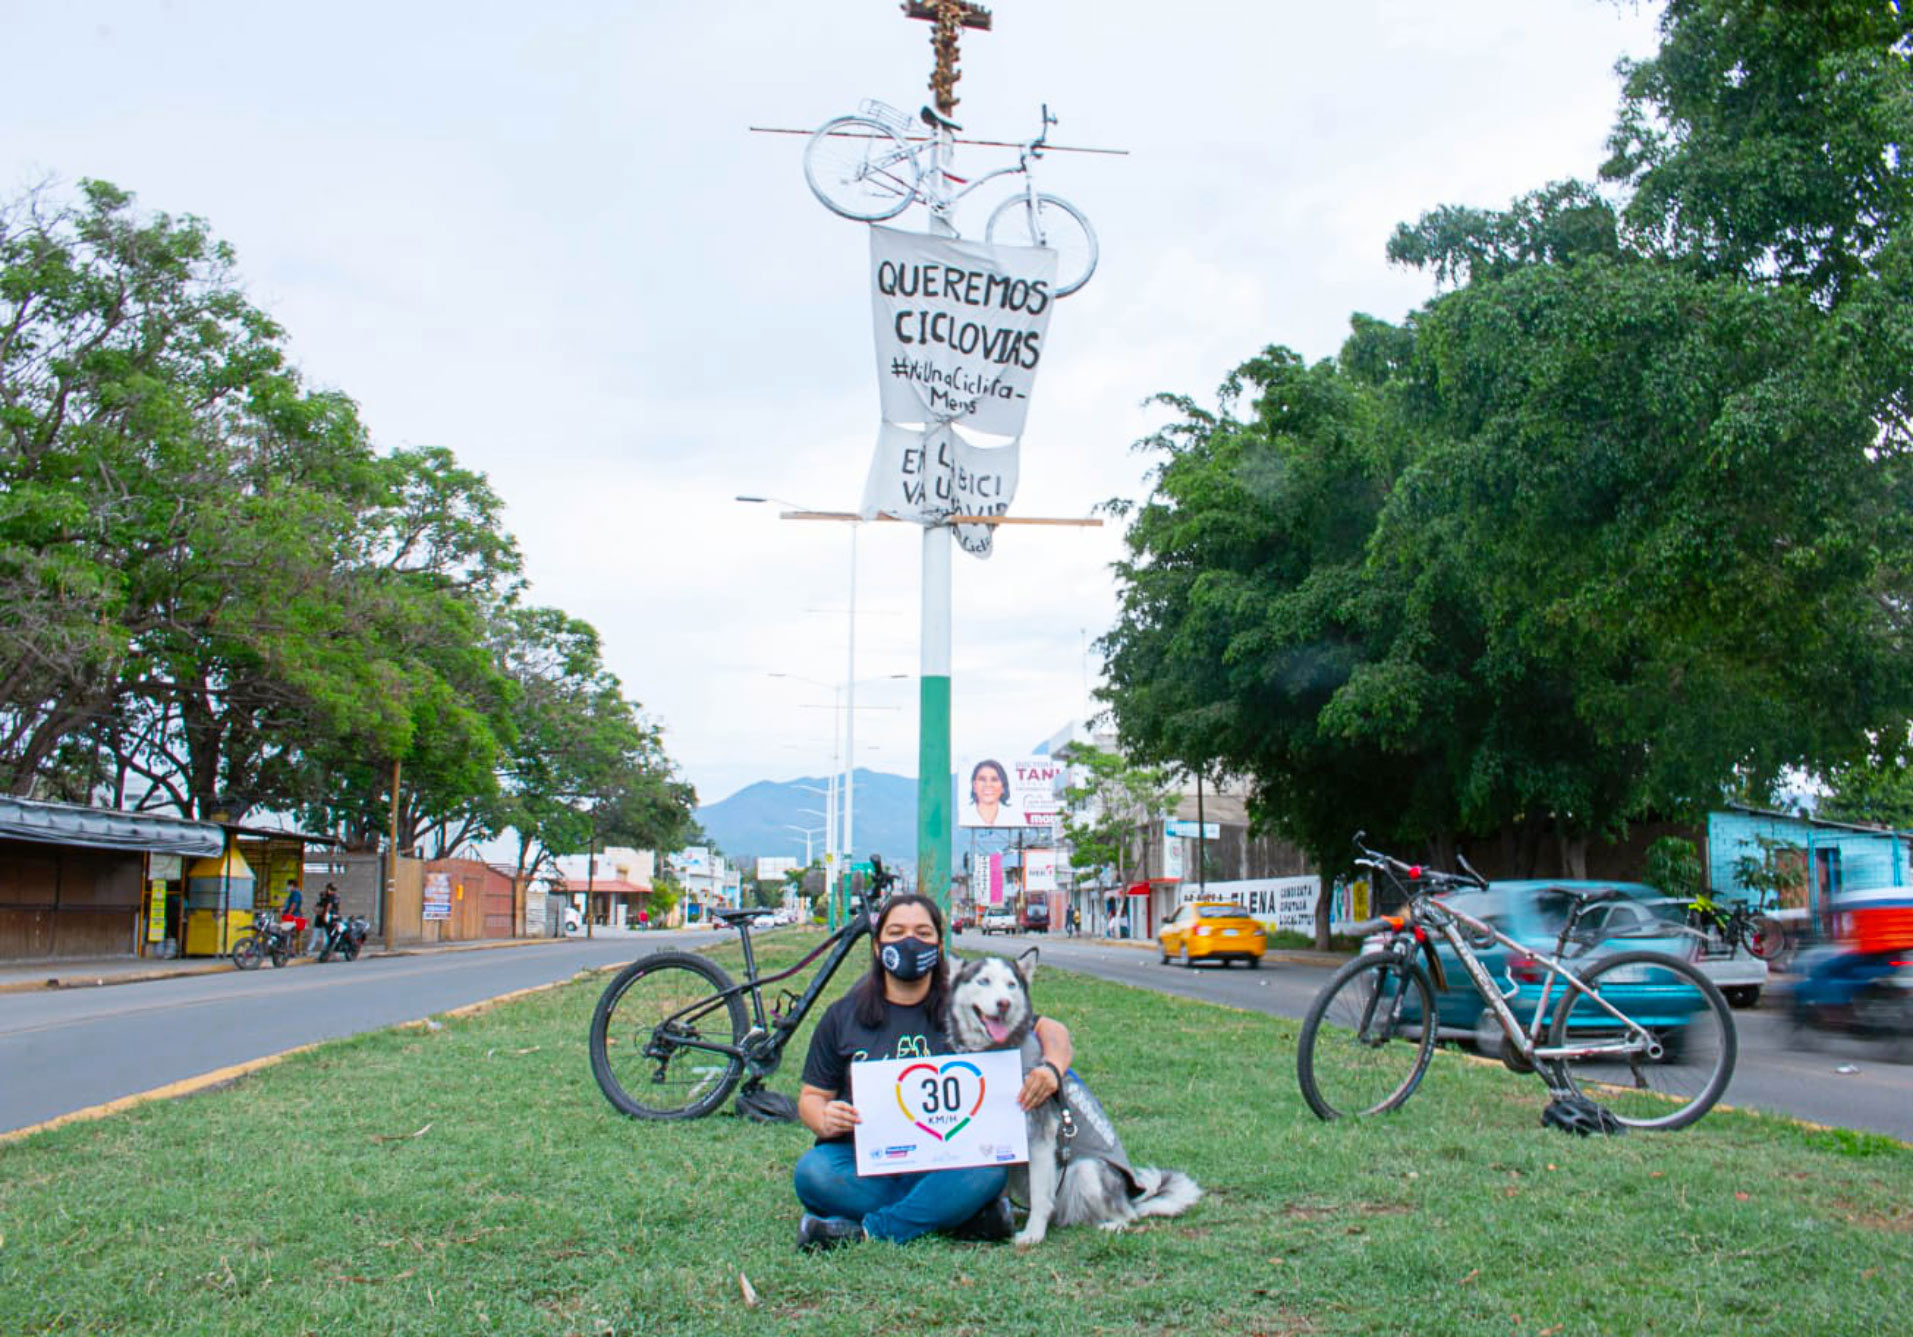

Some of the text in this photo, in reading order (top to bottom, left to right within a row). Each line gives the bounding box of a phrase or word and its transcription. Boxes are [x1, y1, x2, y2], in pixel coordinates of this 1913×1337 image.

[878, 261, 1048, 315] QUEREMOS
[895, 310, 1040, 369] CICLOVIAS
[921, 1076, 960, 1113] 30
[928, 1115, 958, 1124] KM/H
